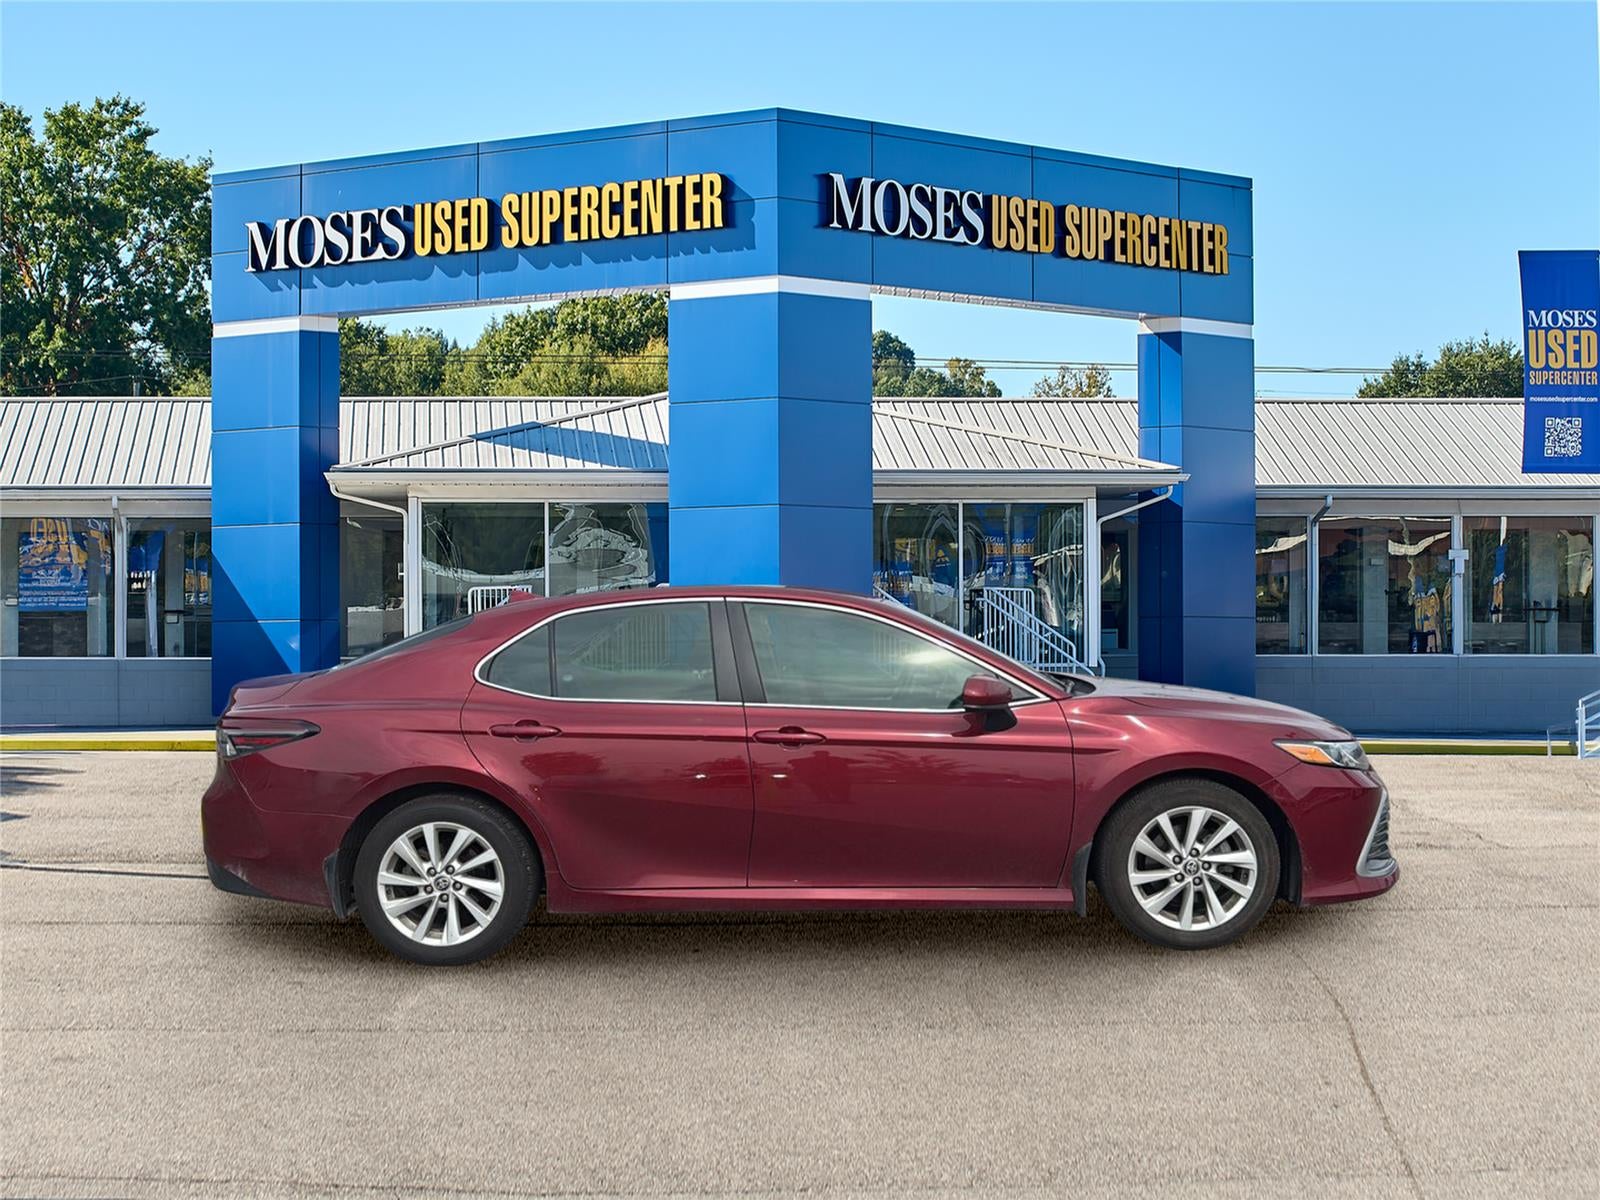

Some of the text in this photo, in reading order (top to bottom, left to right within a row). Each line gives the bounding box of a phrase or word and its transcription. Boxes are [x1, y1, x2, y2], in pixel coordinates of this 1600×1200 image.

[244, 172, 724, 272] MOSES USED SUPERCENTER
[829, 172, 1229, 274] MOSES USED SUPERCENTER
[1527, 309, 1597, 328] MOSES
[1528, 329, 1598, 369] USED
[1529, 371, 1598, 385] SUPERCENTER
